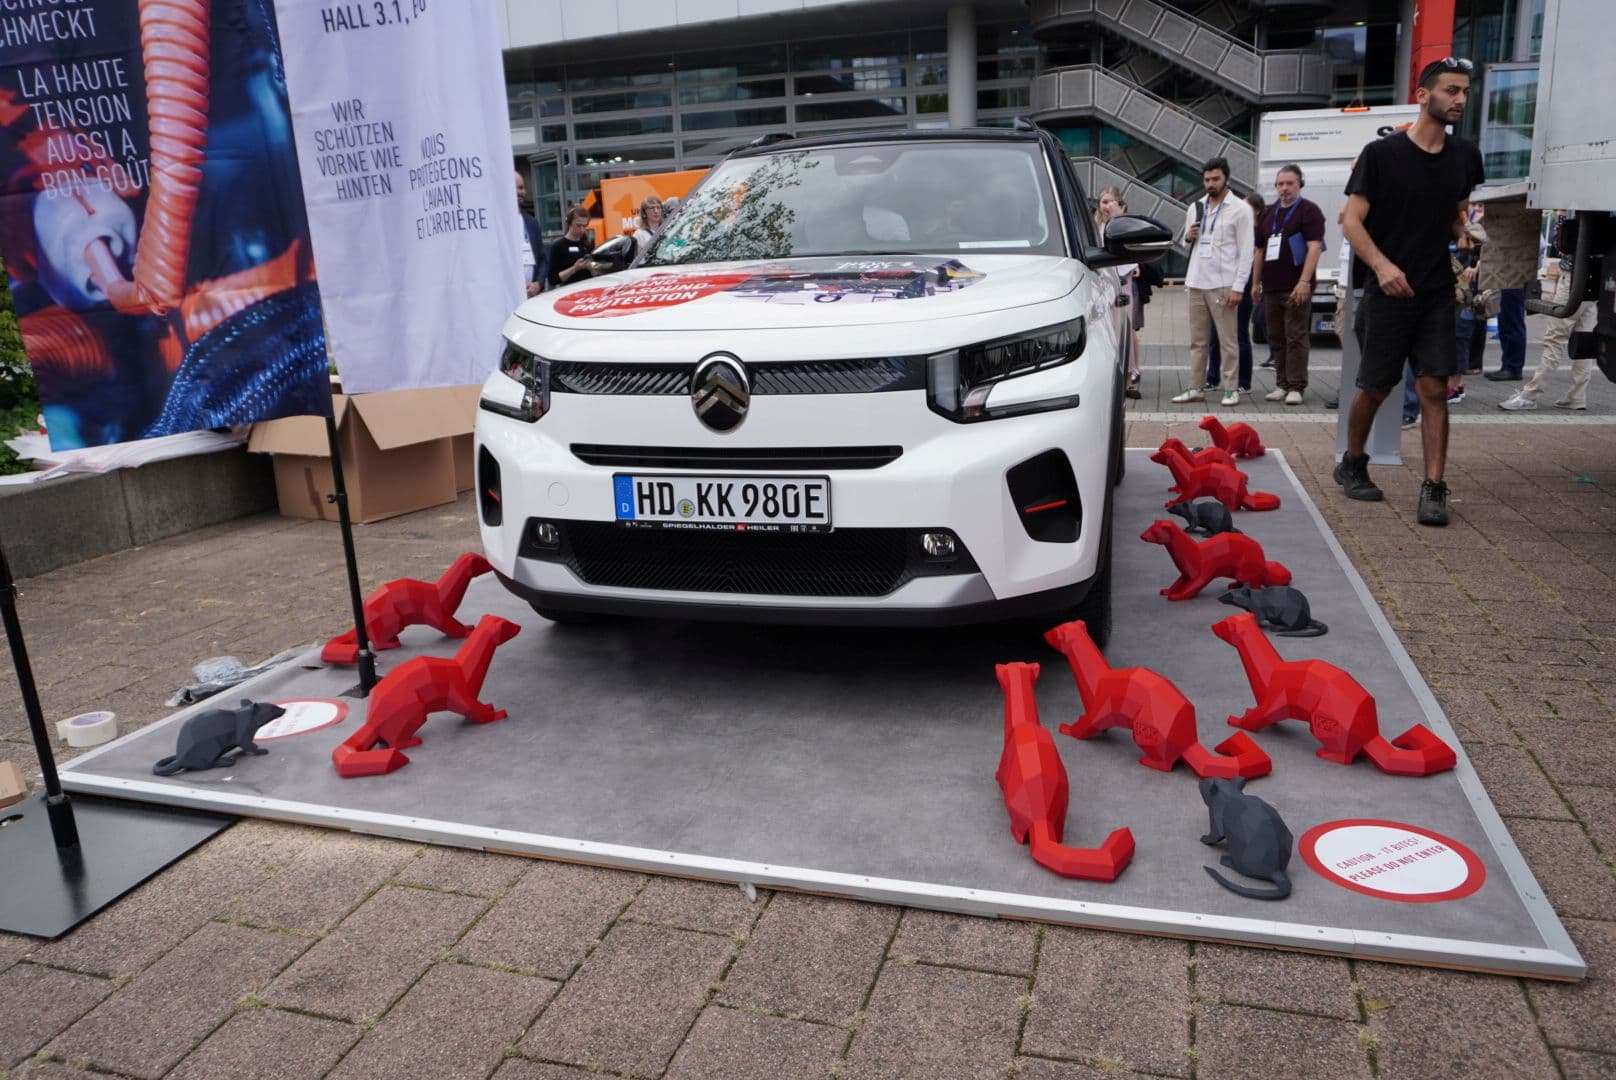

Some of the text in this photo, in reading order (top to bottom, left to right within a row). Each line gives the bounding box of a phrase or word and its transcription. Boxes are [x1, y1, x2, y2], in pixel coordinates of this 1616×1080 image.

[0, 8, 96, 48] HMECKT
[321, 4, 370, 32] HALL
[17, 58, 129, 98] LA HAUTE
[29, 93, 132, 131] TENSION
[331, 98, 365, 122] WIR
[47, 128, 137, 164] AUSSI A
[314, 120, 394, 152] SCHÜTZEN
[316, 146, 403, 176] VORNE WIE
[41, 154, 150, 200] BON GOÛT
[335, 173, 392, 200] HINTEN
[567, 290, 699, 313] PROTECTION
[621, 502, 630, 513] D
[637, 481, 824, 519] HD KK 980E
[662, 522, 735, 531] SPIEGELHALDER
[1335, 852, 1377, 870] CAUTION
[1348, 844, 1448, 882] PLEASE DO NOT ENTER
